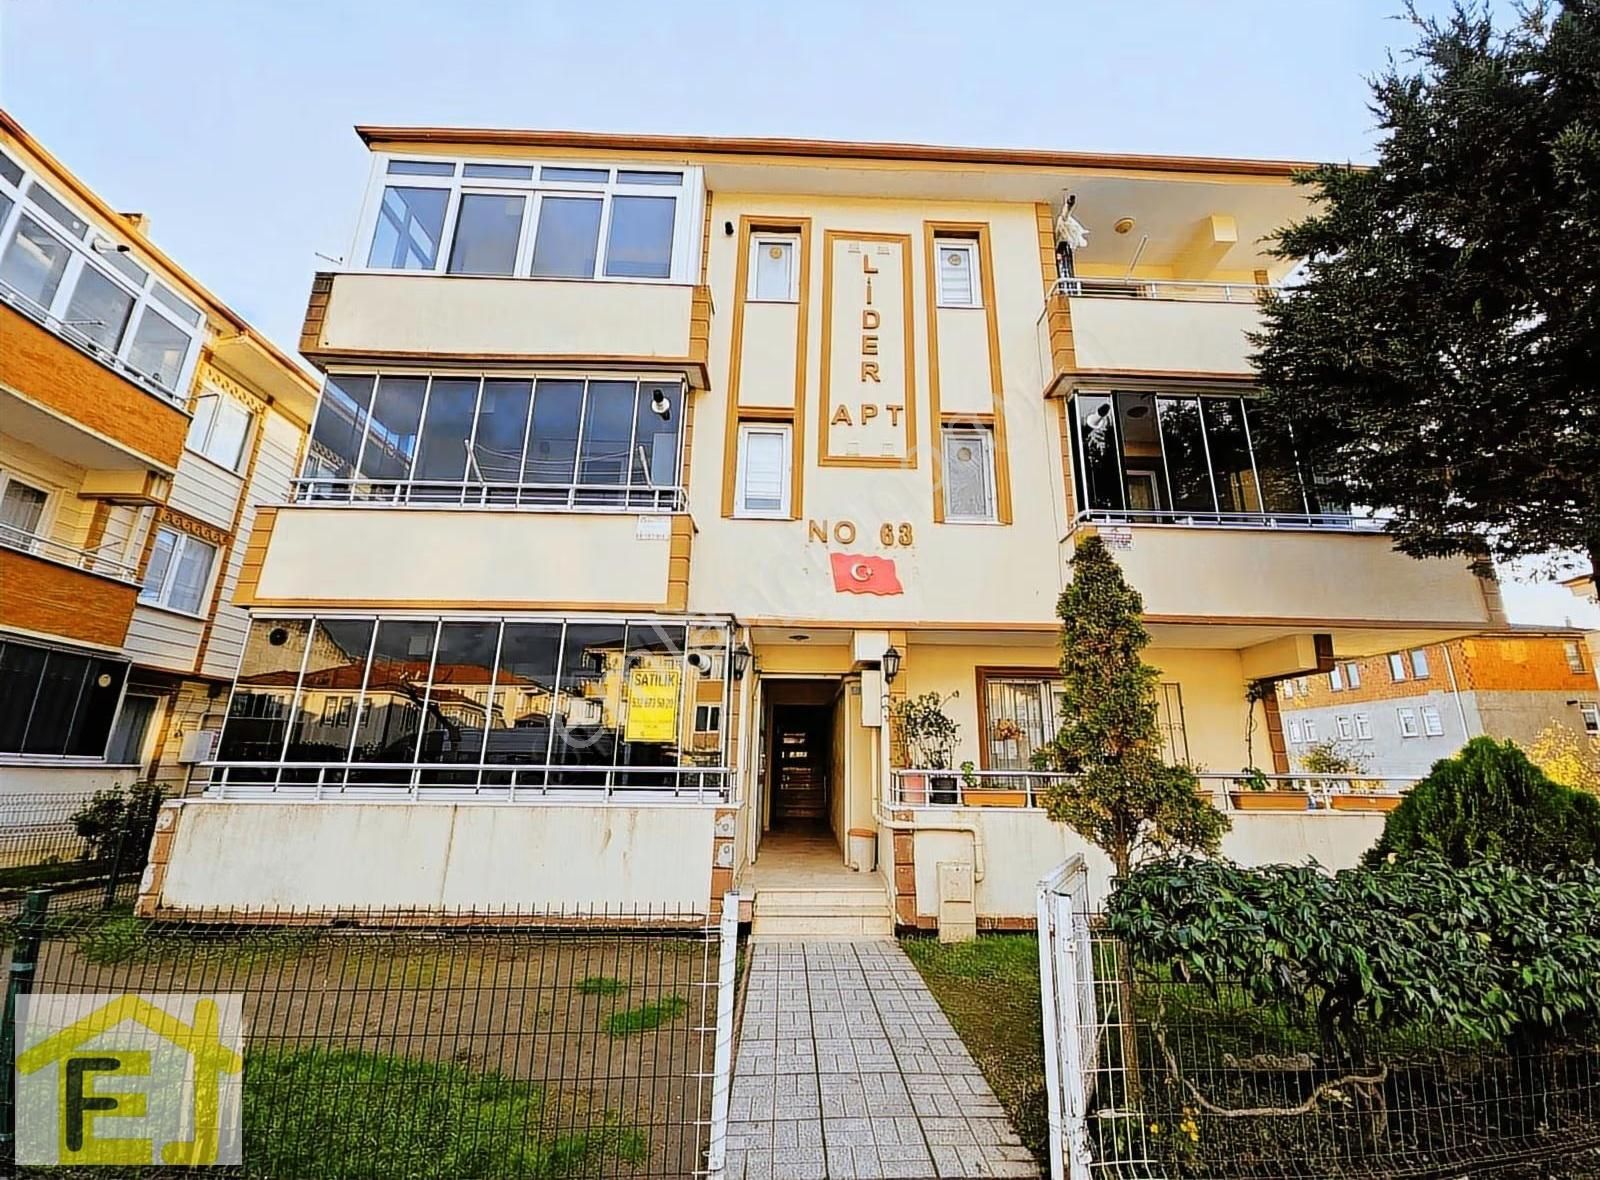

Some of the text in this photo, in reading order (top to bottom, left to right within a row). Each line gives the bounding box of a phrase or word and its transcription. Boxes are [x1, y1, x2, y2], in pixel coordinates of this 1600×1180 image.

[831, 404, 904, 427] APT
[808, 519, 913, 546] NO 63
[635, 673, 676, 687] SATILIK
